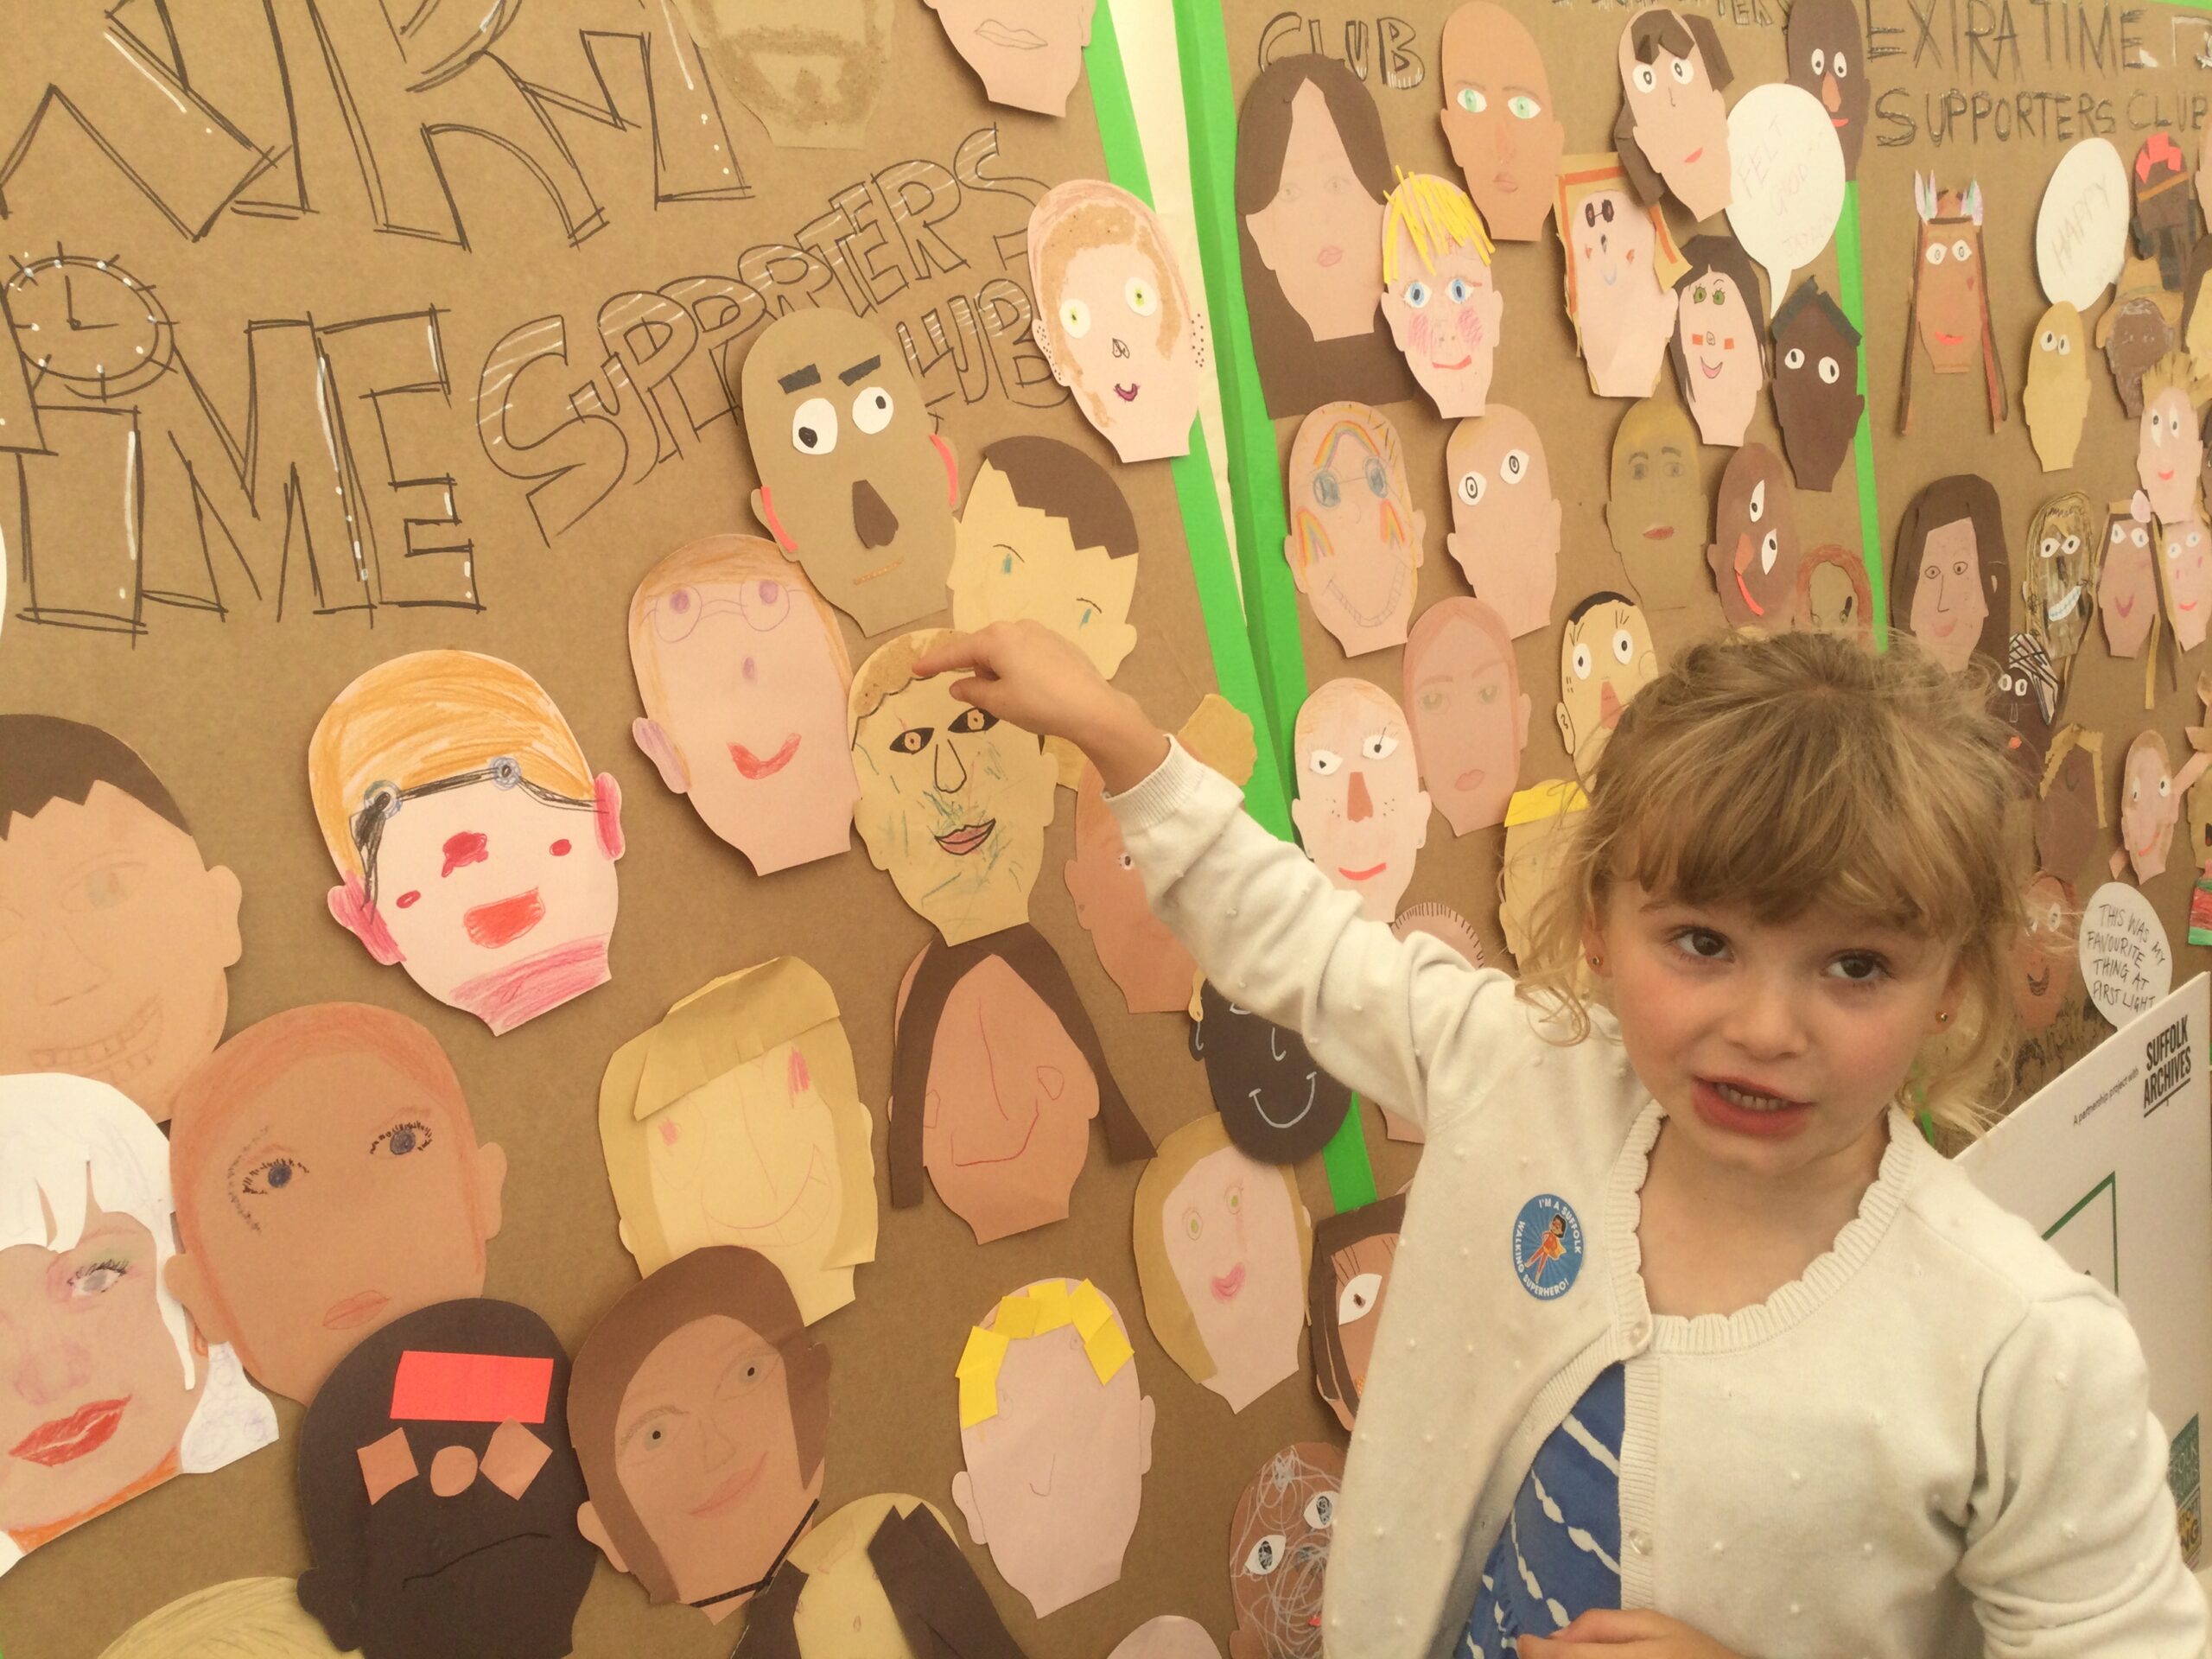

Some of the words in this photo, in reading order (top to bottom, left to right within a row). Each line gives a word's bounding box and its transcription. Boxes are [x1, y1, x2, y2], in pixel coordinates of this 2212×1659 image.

[2031, 0, 2148, 78] TIME
[1875, 86, 2115, 147] SUPPORTERS
[2051, 173, 2110, 277] HAPPY
[2087, 931, 2145, 969] FAVOURITE
[2099, 904, 2126, 927] THIS
[2127, 912, 2150, 944] WAS
[2152, 941, 2166, 965] MY
[2093, 957, 2130, 983] THING
[2132, 970, 2150, 991] AT
[2093, 981, 2121, 1006] FIRST
[2122, 995, 2156, 1014] LIGHT
[2146, 1014, 2188, 1071] SUFFOLK
[2078, 1093, 2109, 1124] partnership
[2109, 1077, 2127, 1098] project
[2128, 1066, 2139, 1082] with
[2144, 1046, 2191, 1109] ARCHIVES
[1538, 1198, 1551, 1209] I'M
[1553, 1201, 1560, 1211] A
[1560, 1206, 1582, 1255] SUFFOLK
[1515, 1220, 1526, 1274] WALKING
[1522, 1274, 1570, 1297] SUPERHERO!
